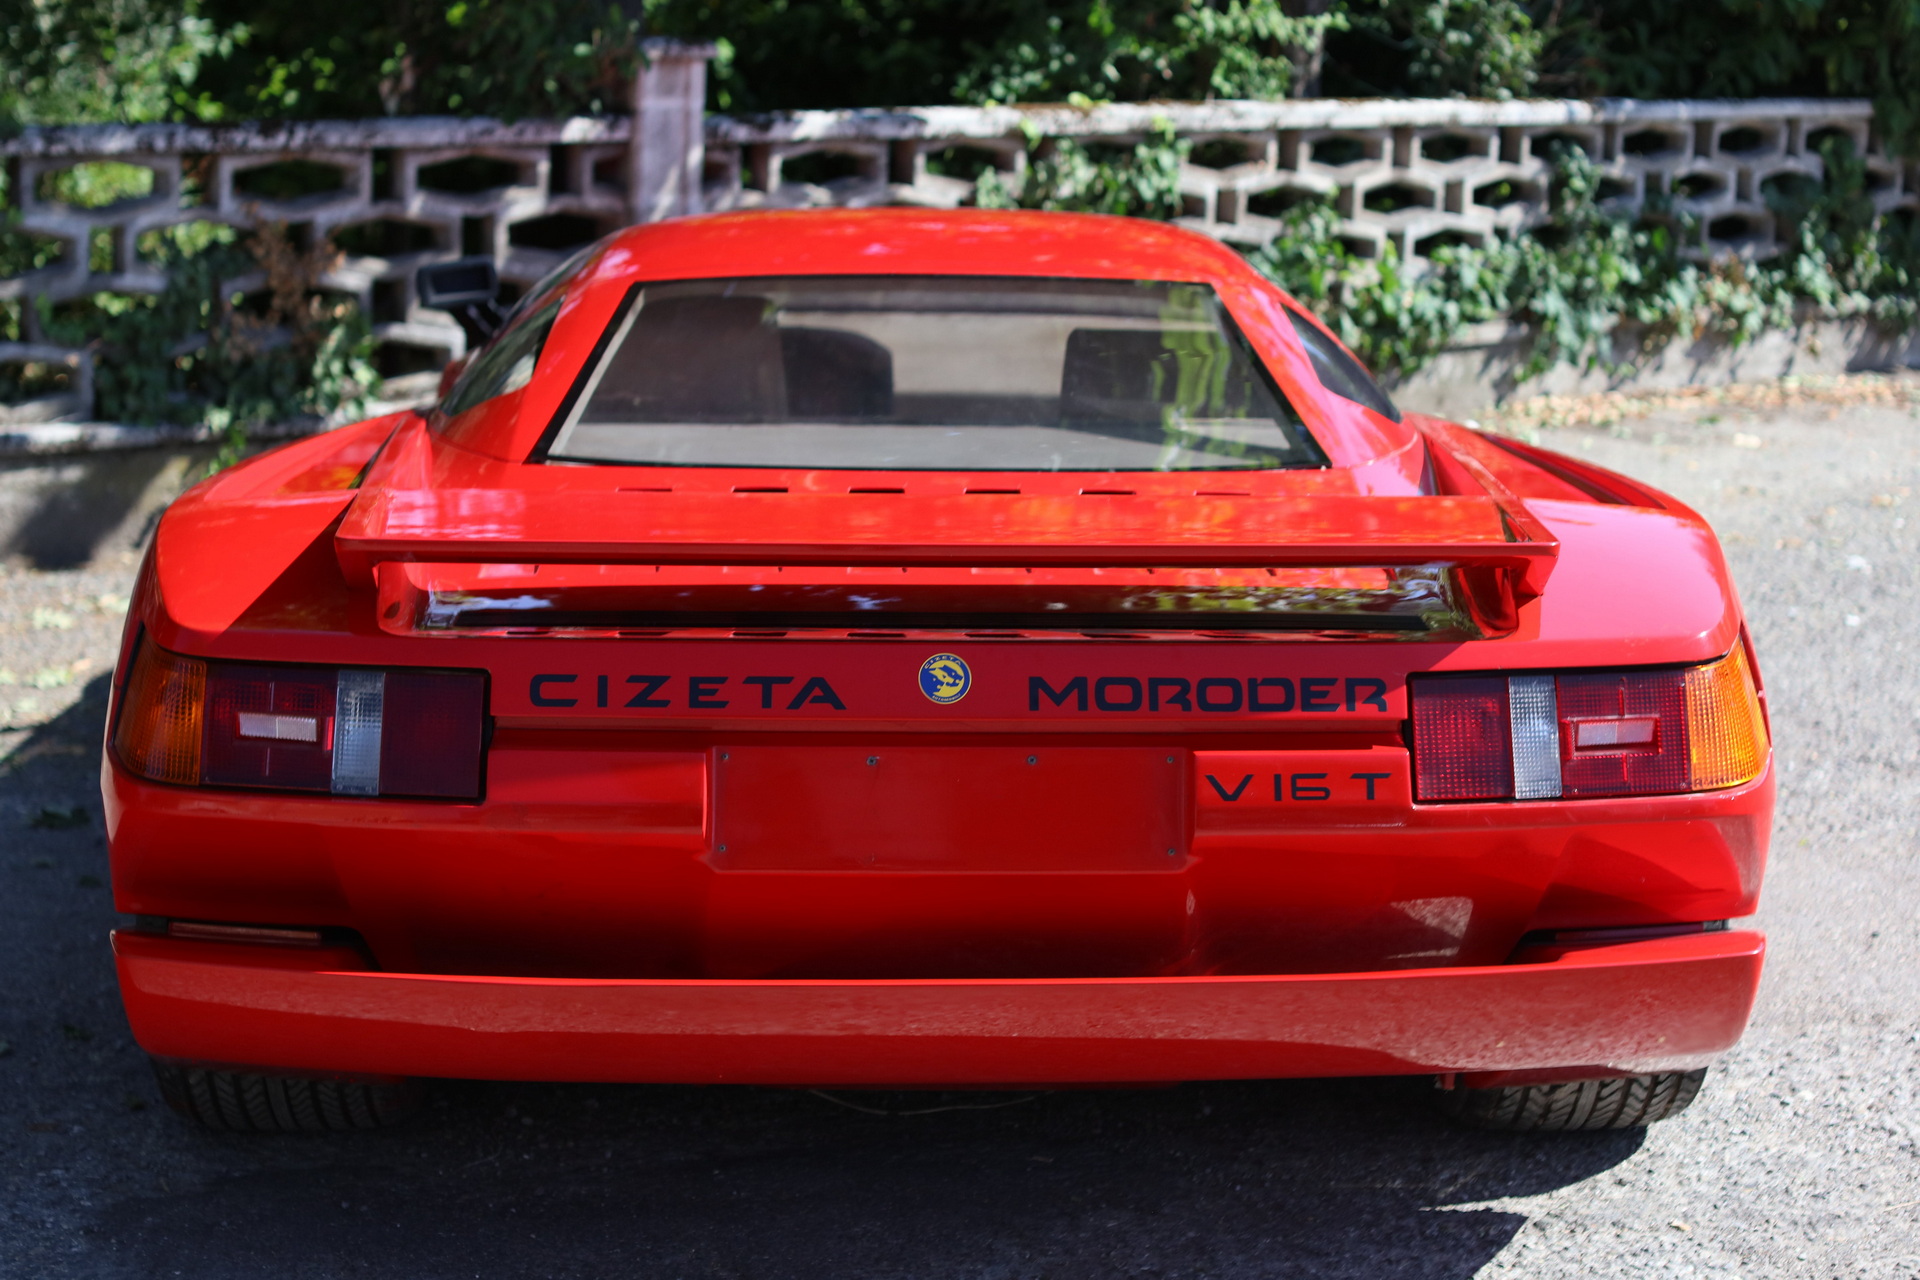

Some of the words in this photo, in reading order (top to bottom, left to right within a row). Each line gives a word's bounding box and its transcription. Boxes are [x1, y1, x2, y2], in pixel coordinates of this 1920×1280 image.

[924, 655, 962, 669] CIZETA
[529, 673, 847, 711] CIZETA
[1028, 676, 1388, 713] MORODER
